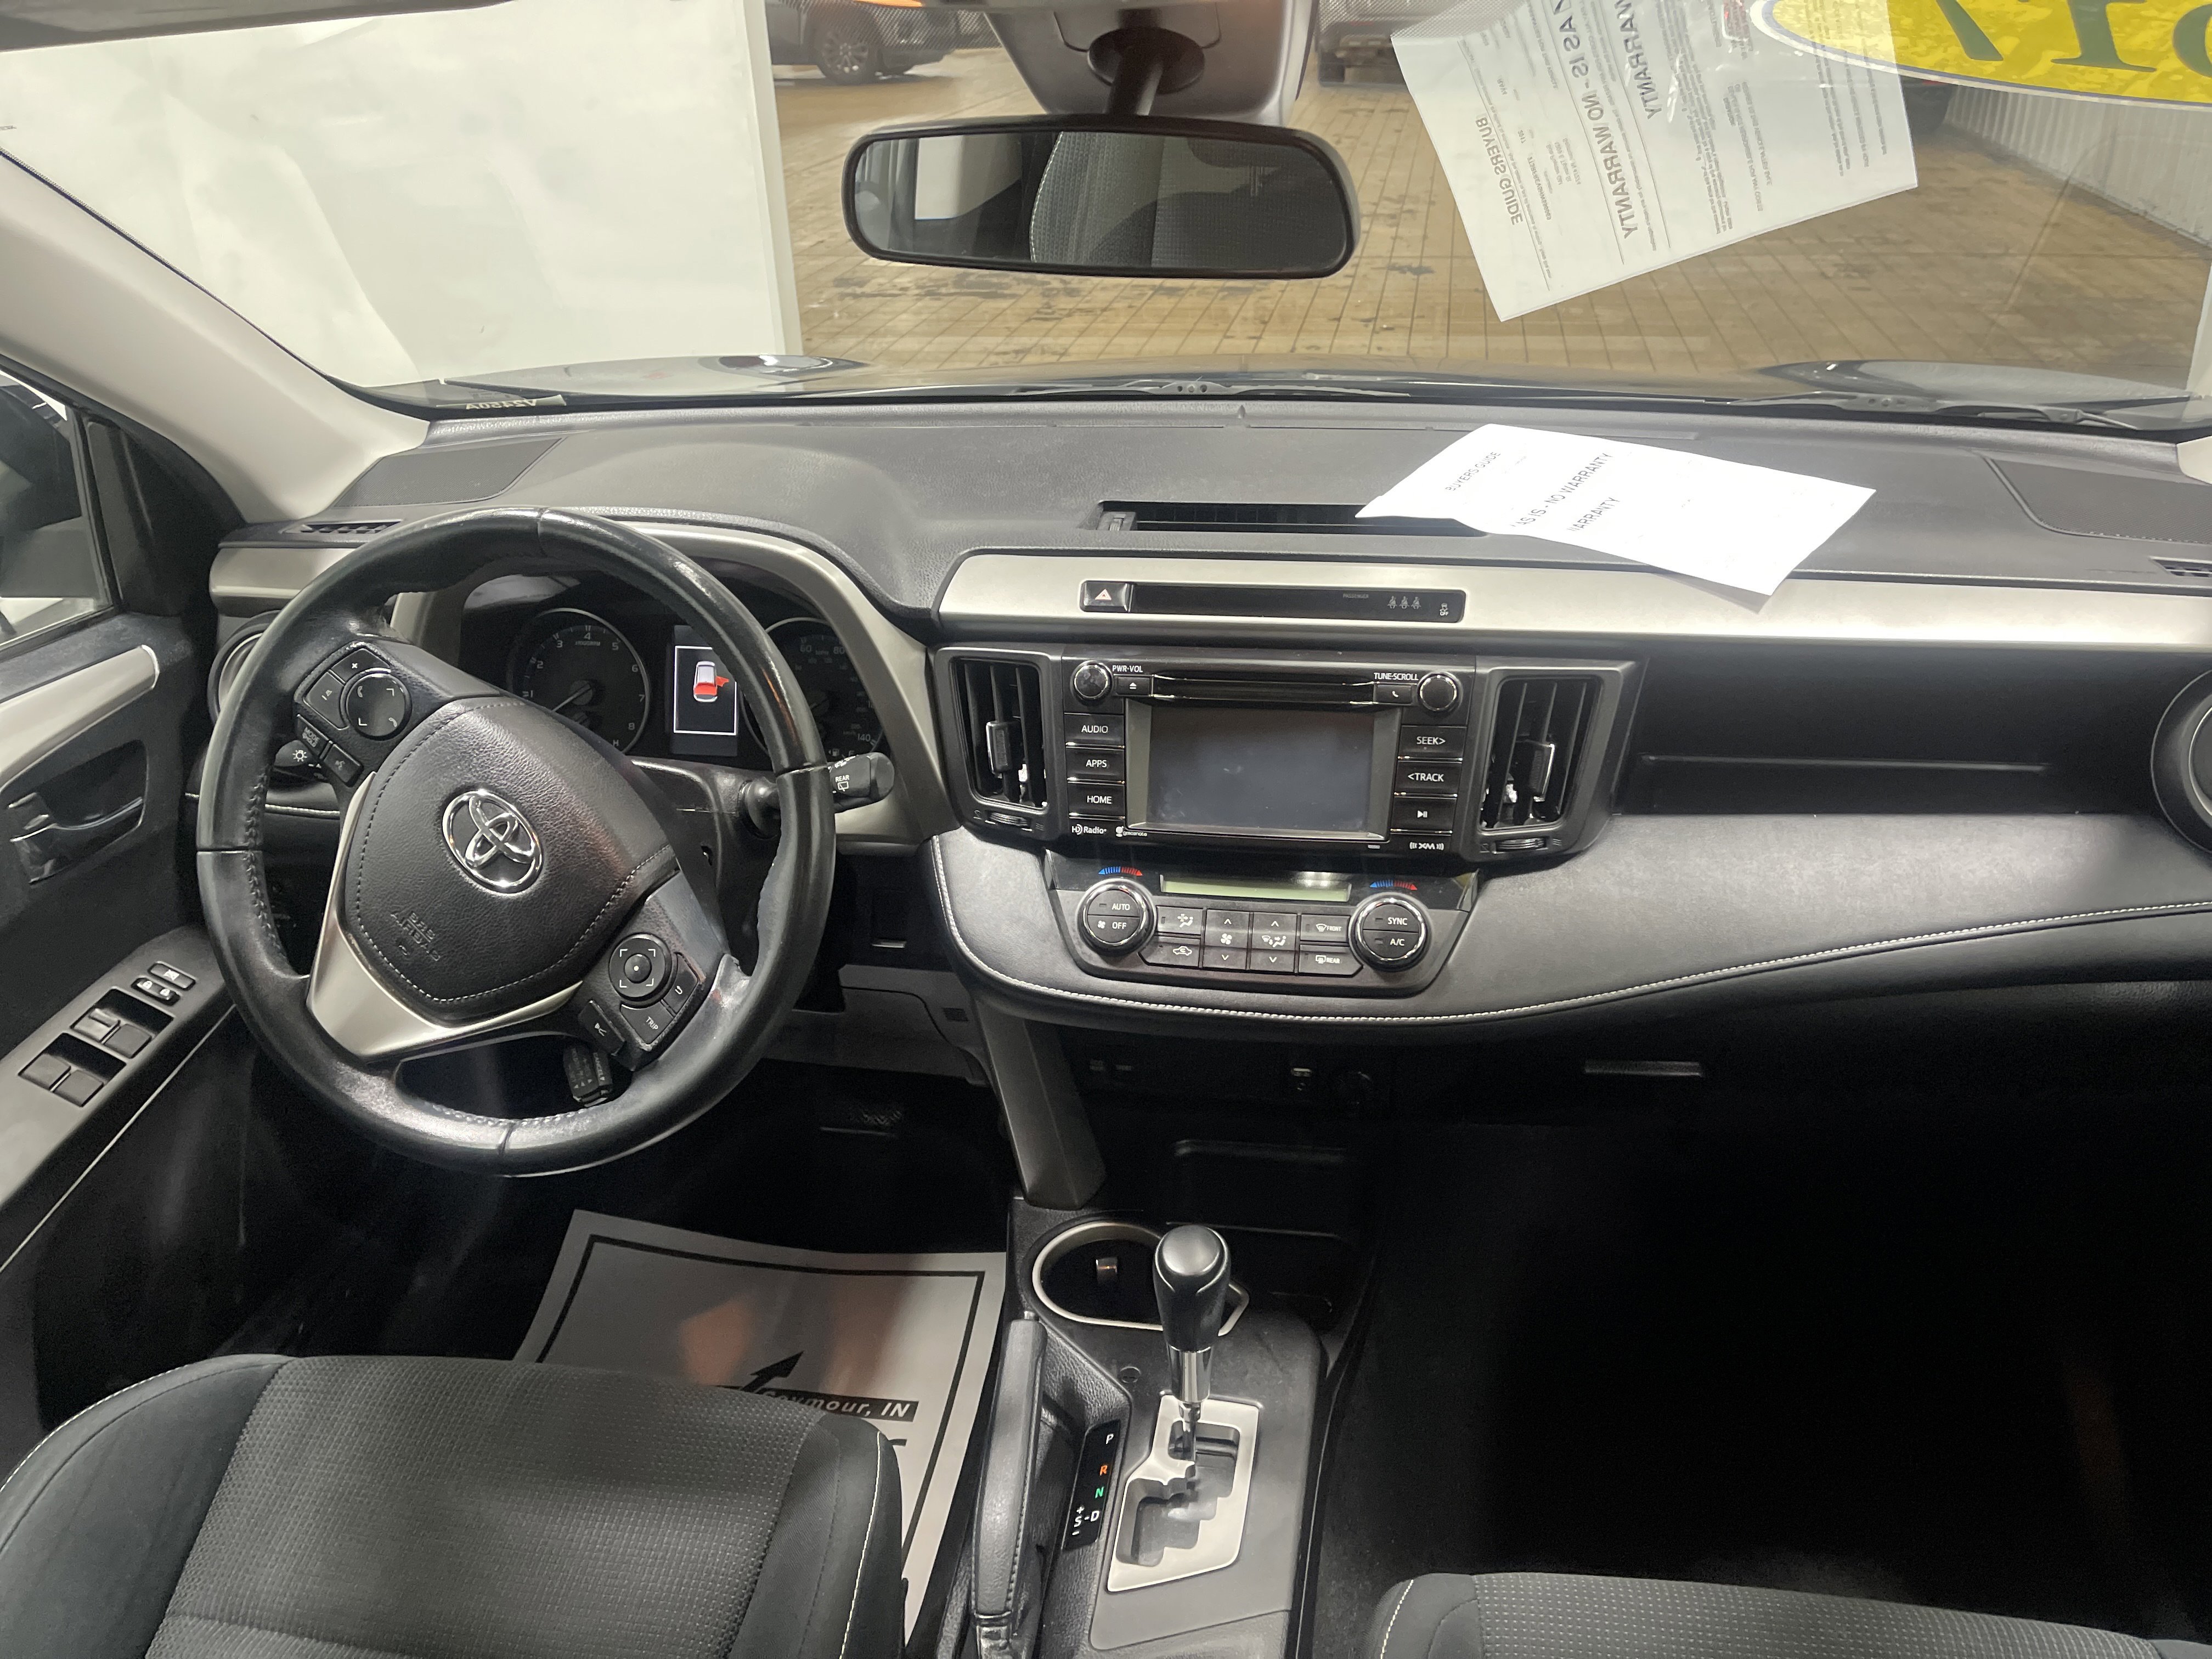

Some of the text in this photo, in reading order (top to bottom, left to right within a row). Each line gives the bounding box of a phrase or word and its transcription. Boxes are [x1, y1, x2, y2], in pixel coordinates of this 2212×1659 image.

[1445, 451, 1502, 492] BUYERS GUIDE
[1531, 508, 1547, 518] IS
[1544, 494, 1566, 504] NO
[1559, 452, 1614, 493] WARRANTY
[612, 642, 619, 651] 5
[537, 661, 544, 669] 2
[639, 695, 645, 703] 7
[1081, 724, 1108, 734] AUDIO
[304, 726, 320, 743] MODE
[857, 733, 871, 742] 140
[1086, 759, 1108, 769] APPS
[1087, 795, 1112, 805] HOME
[1111, 902, 1131, 912] AUTO
[1111, 921, 1127, 930] OFF
[1387, 917, 1408, 927] SYNC
[1390, 936, 1405, 947] A/C
[646, 1016, 658, 1031] TRIP
[882, 1402, 911, 1418] IN
[1105, 1433, 1114, 1444] P
[1099, 1465, 1108, 1476] R
[1094, 1486, 1104, 1498] N
